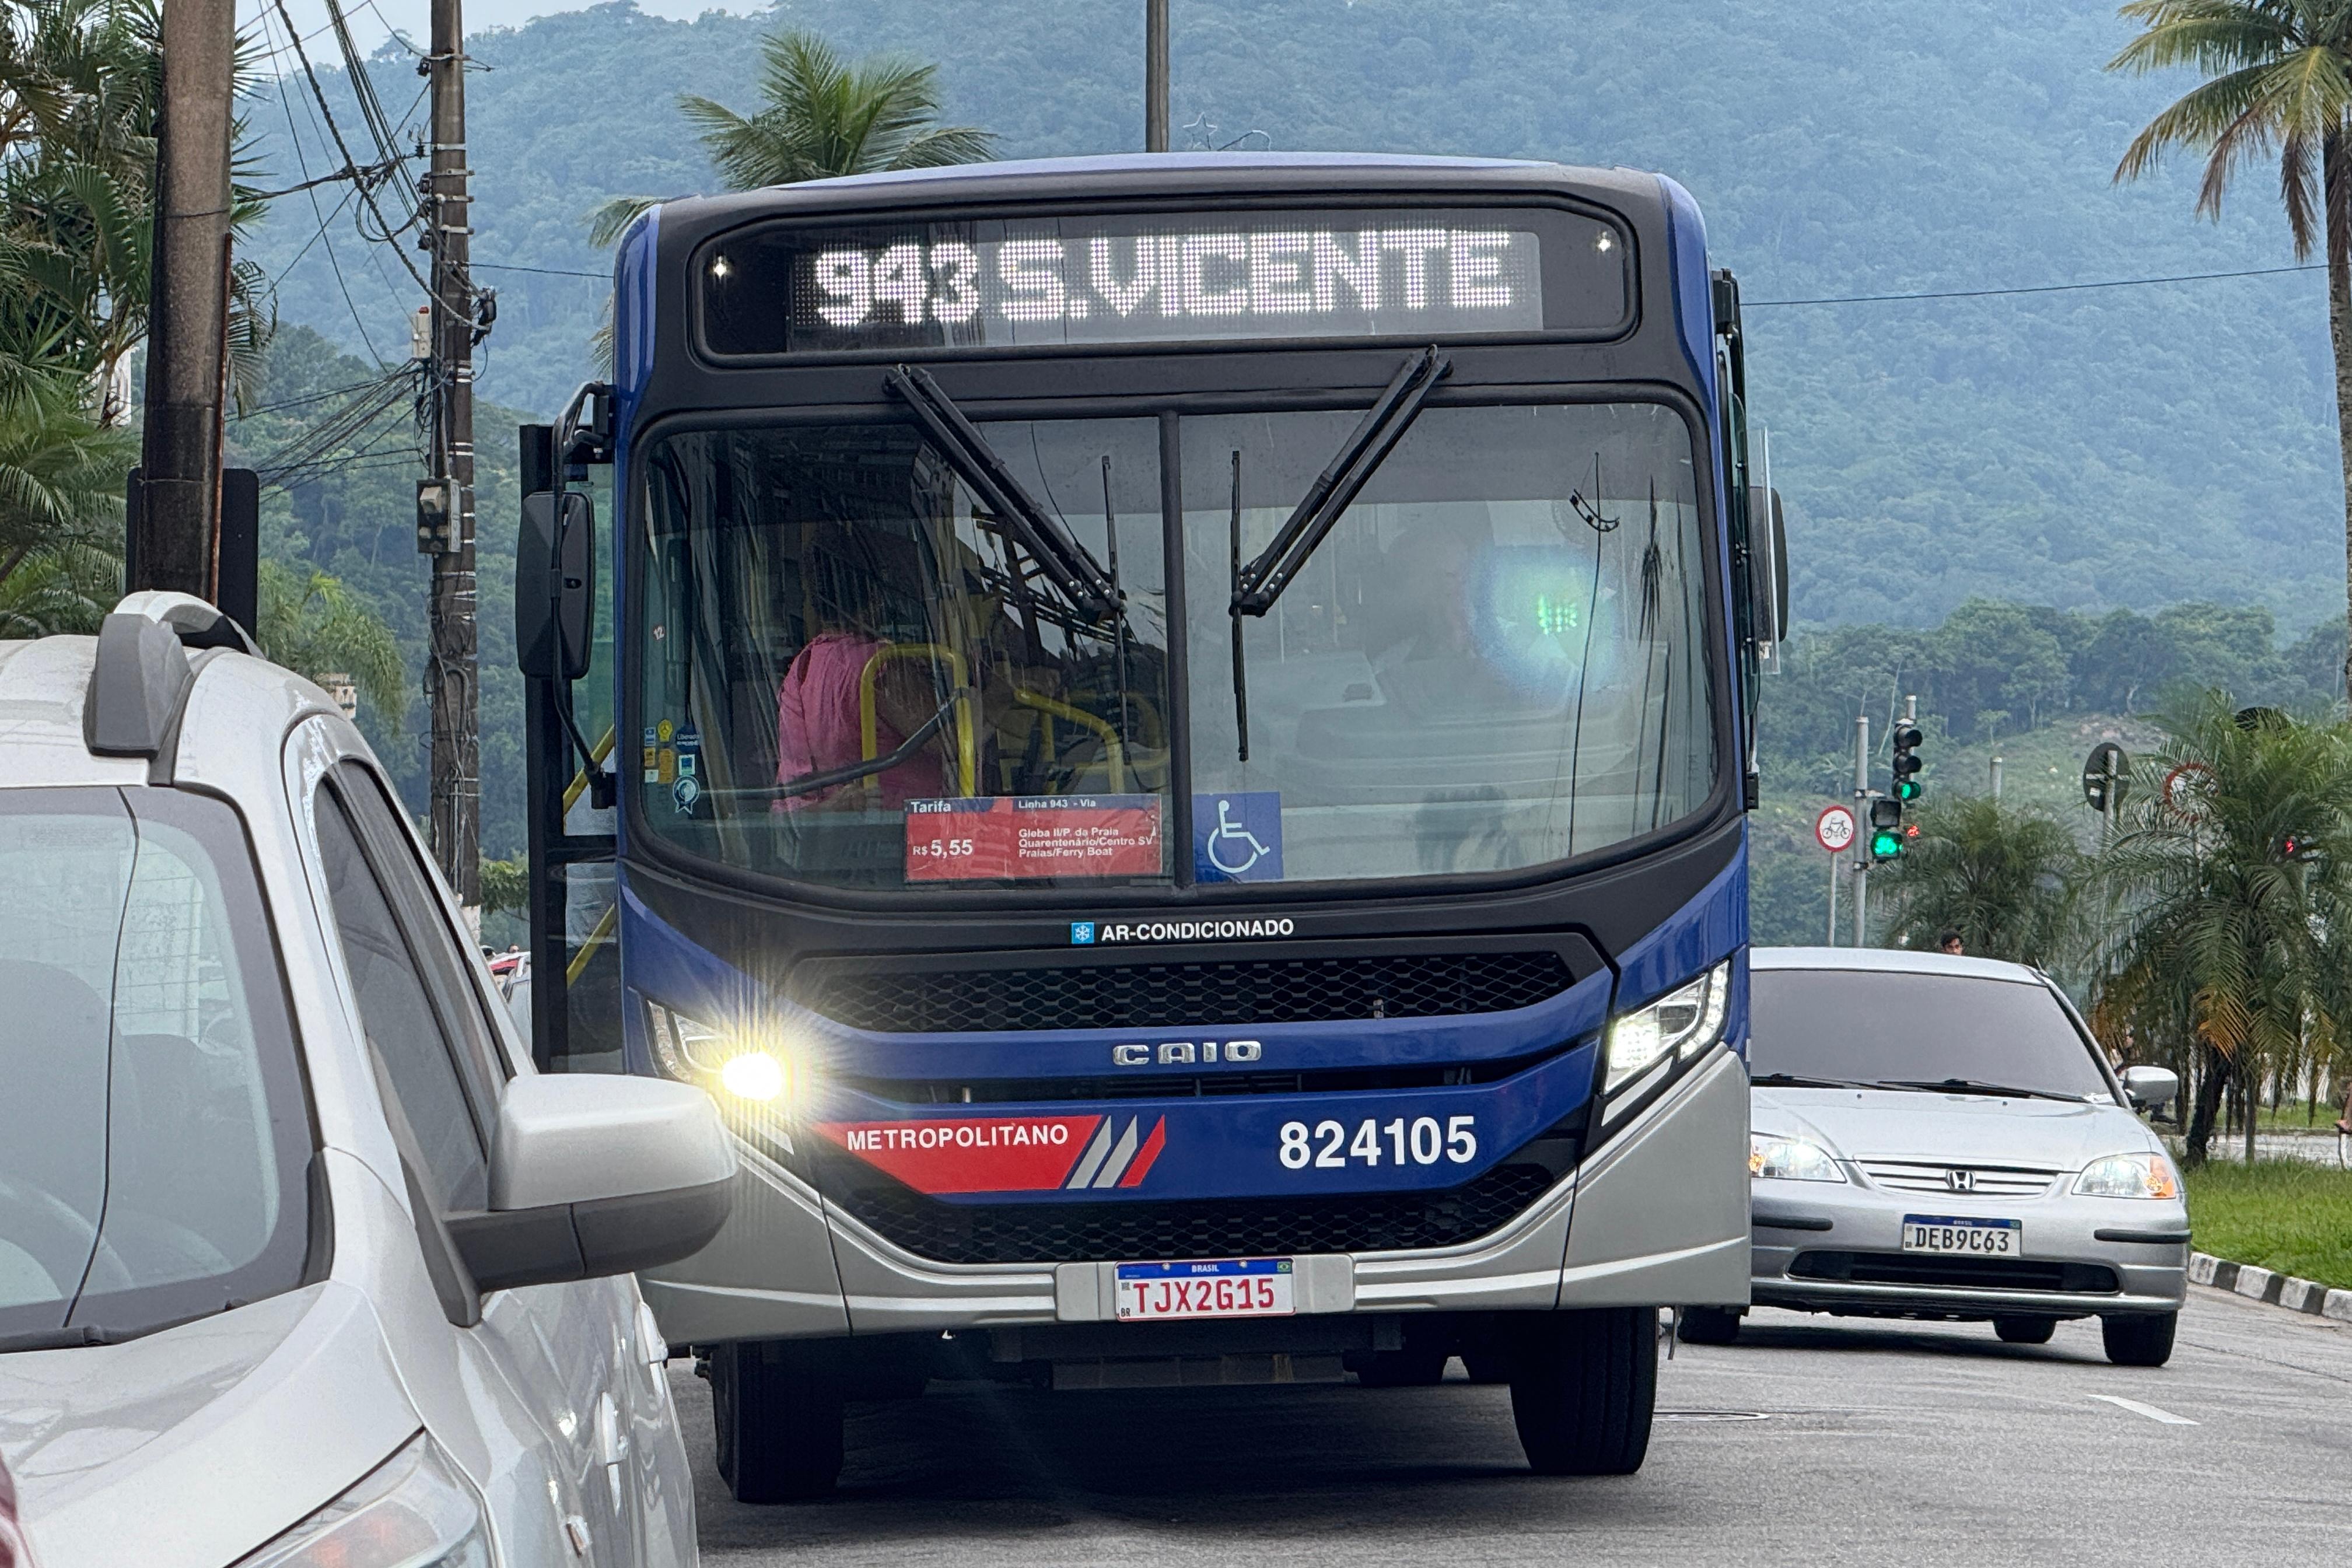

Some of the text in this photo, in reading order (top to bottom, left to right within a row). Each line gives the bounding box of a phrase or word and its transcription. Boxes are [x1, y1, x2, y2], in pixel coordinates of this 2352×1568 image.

[816, 229, 1511, 325] 943 S.VICENTE
[911, 801, 951, 813] Tarifa
[1019, 799, 1047, 808] Linha
[1050, 799, 1068, 808] 943
[1079, 799, 1096, 807] Via
[1091, 827, 1119, 836] Praia
[912, 839, 973, 859] R$ 5,55
[1019, 846, 1113, 859] Praias/Ferry Boat
[1101, 918, 1294, 942] AR-CONDICIONADO
[1112, 1041, 1262, 1066] CAIO
[847, 1124, 1069, 1151] METROPOLITANO
[1279, 1115, 1477, 1169] 824105
[1915, 1227, 2009, 1252] DEB9C63
[1191, 1264, 1220, 1273] BRASIL
[1133, 1278, 1275, 1314] TJX2G15
